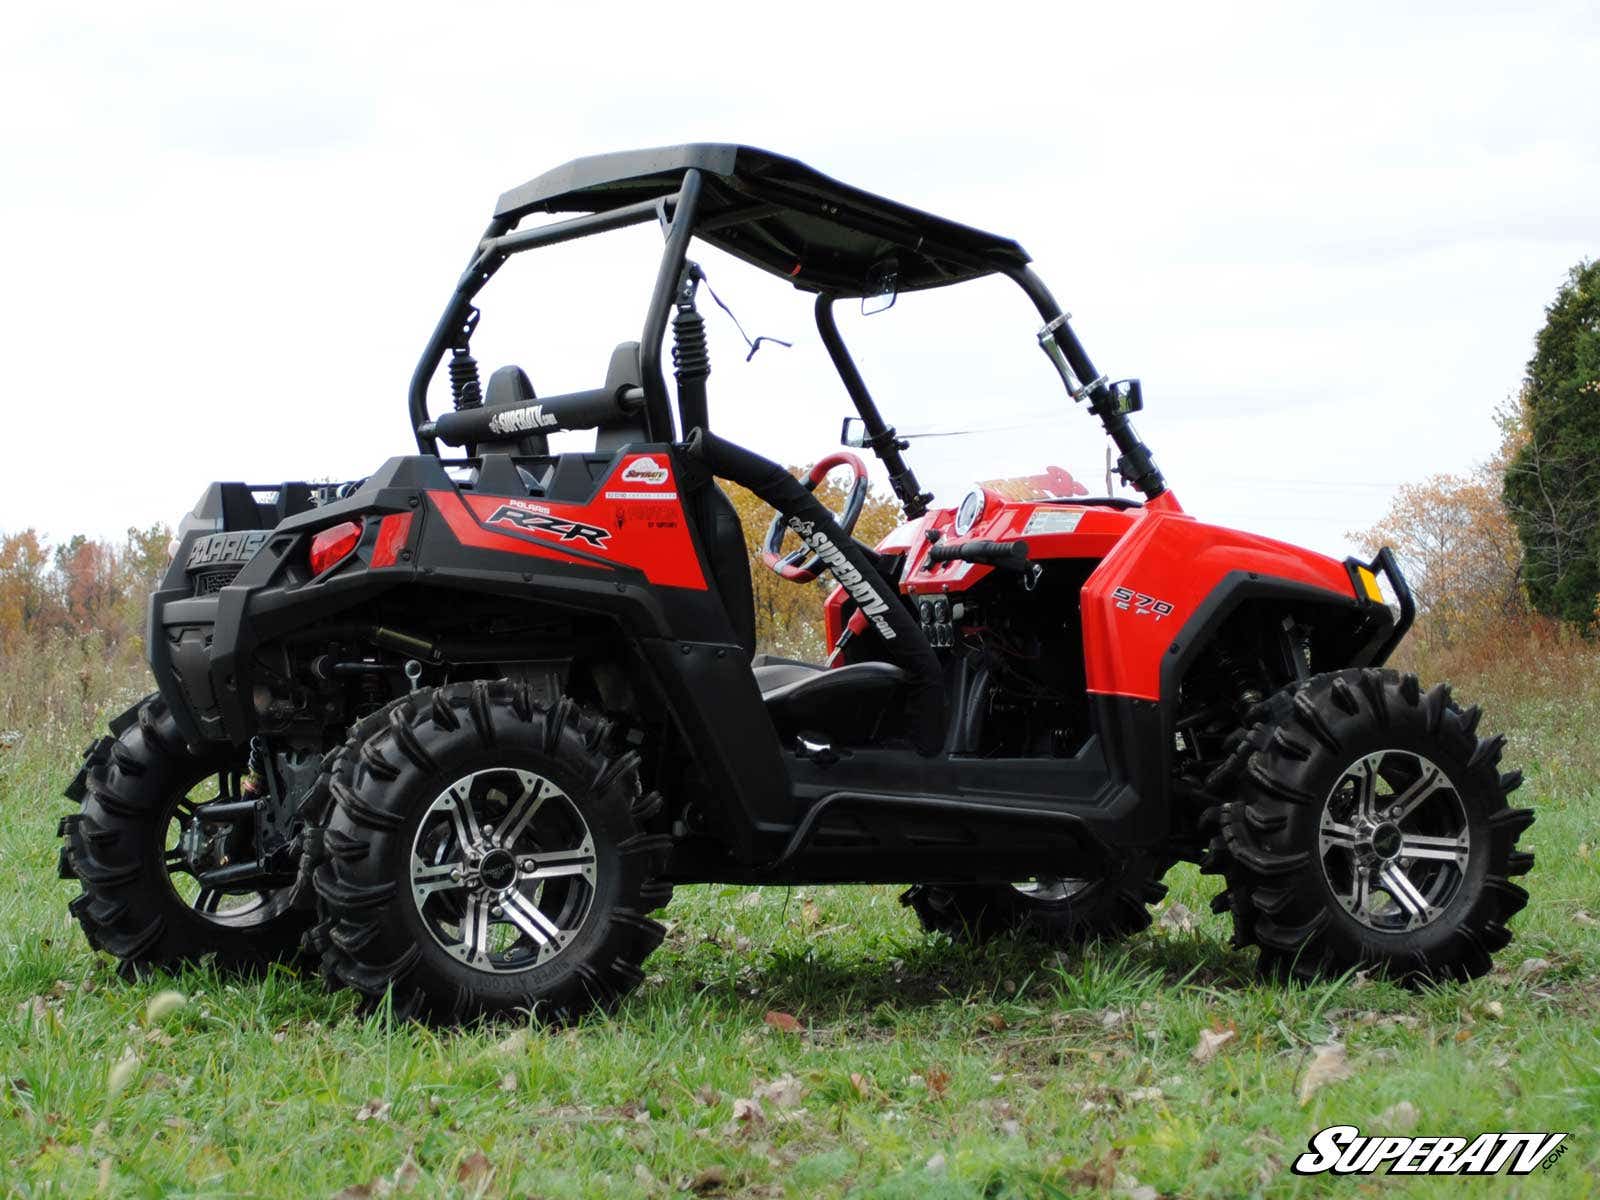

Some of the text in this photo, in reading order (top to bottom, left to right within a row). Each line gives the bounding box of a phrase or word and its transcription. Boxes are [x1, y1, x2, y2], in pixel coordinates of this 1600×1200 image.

[509, 499, 550, 514] POLARIS
[486, 504, 612, 550] RZR
[187, 534, 265, 566] POLARIS
[1111, 586, 1174, 616] 570
